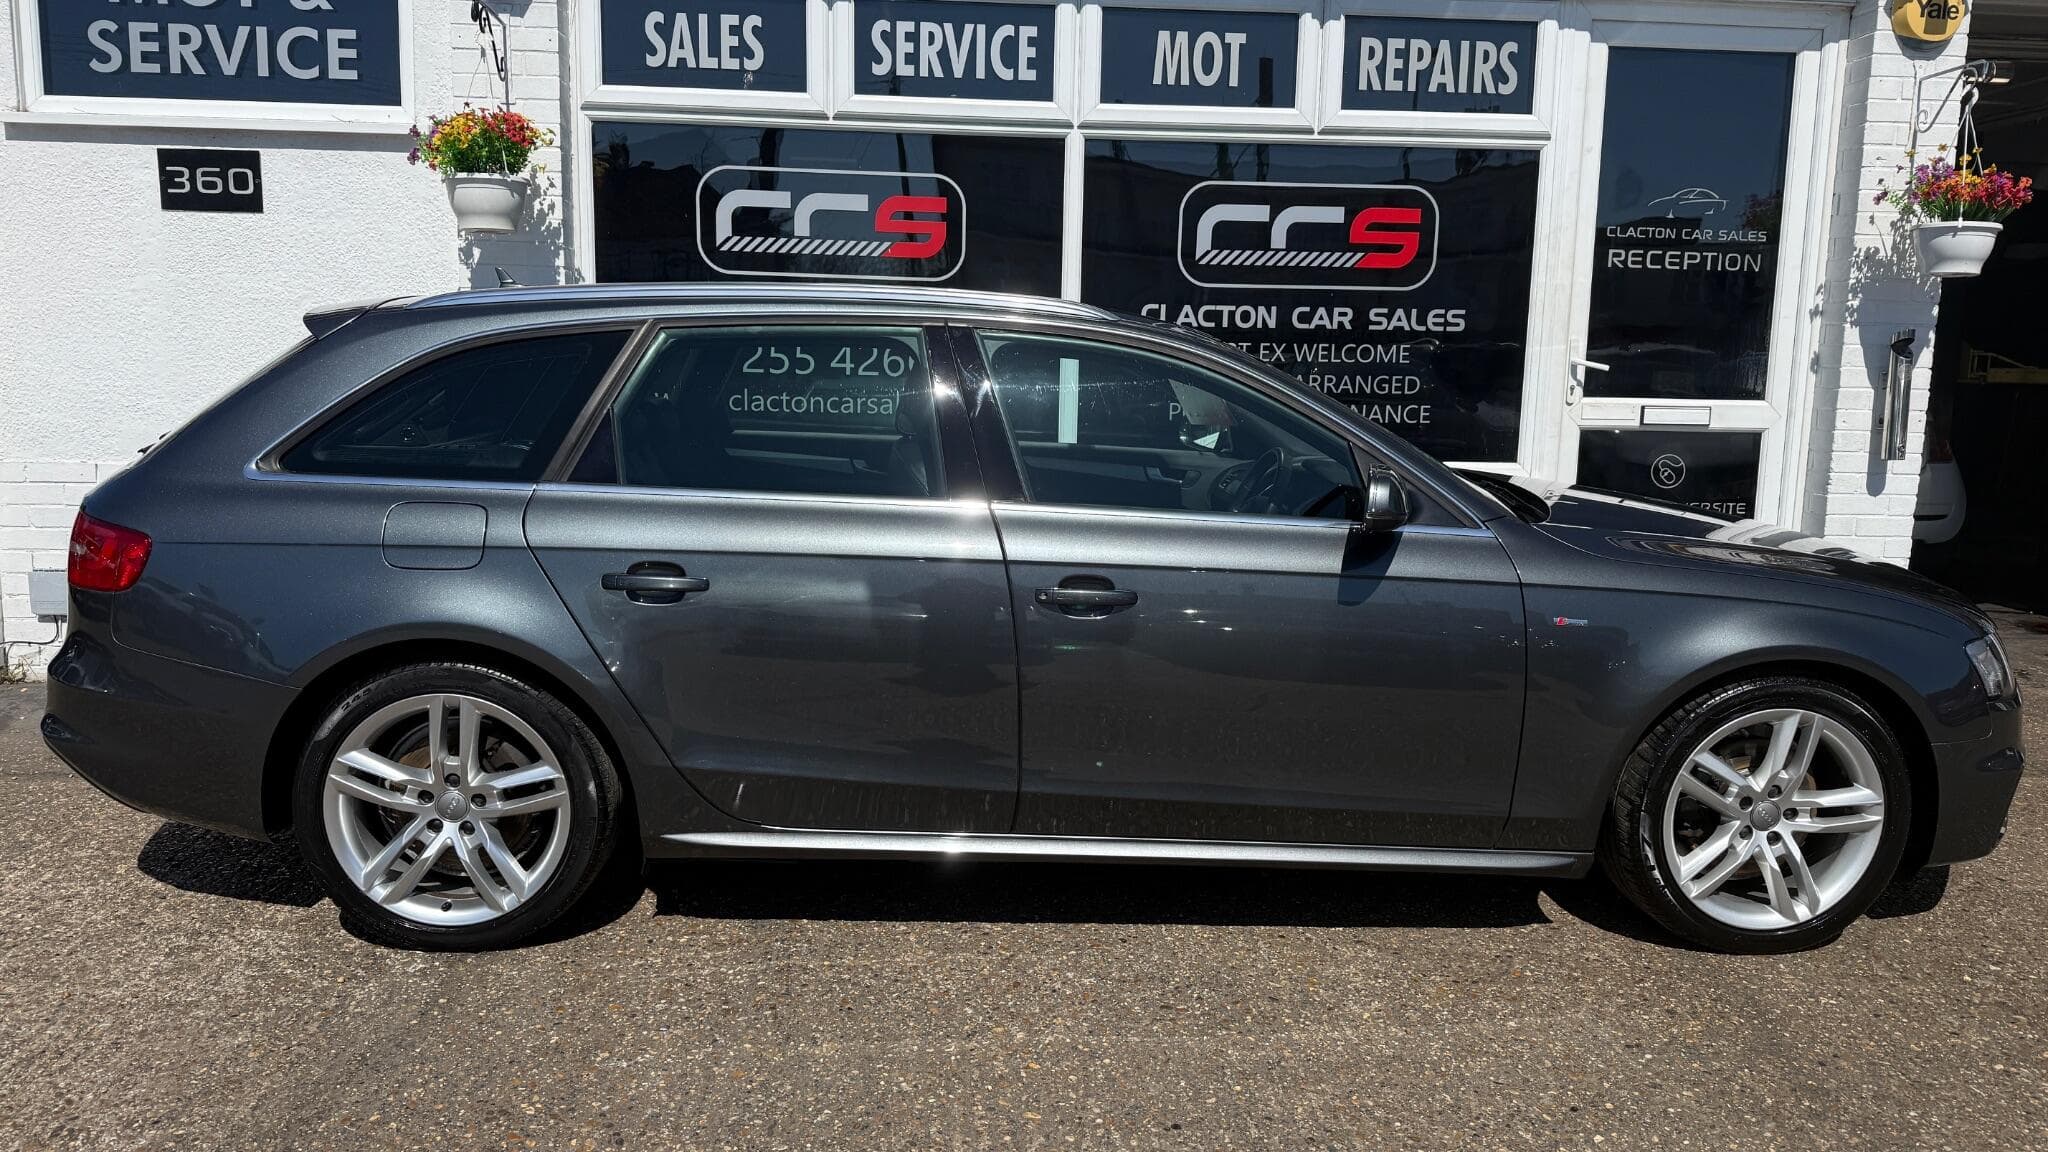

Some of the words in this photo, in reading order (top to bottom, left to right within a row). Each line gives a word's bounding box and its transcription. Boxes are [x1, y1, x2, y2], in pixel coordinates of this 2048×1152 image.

[1917, 0, 1960, 20] Yale
[87, 19, 359, 80] SERVICE
[644, 11, 765, 72] SALES
[870, 19, 1038, 82] SERVICE
[1152, 30, 1247, 88] MOT
[1358, 36, 1519, 96] REPAIRS
[165, 165, 255, 196] 360
[1606, 226, 1676, 240] CLACTON
[1682, 228, 1713, 241] CAR
[1718, 229, 1768, 242] SALES
[1607, 248, 1762, 272] RECEPTION
[1291, 306, 1352, 330] CAR
[1368, 308, 1466, 332] SALES
[1259, 342, 1286, 362] EX
[1293, 343, 1411, 364] WELCOME
[1296, 374, 1420, 395] RRANGED
